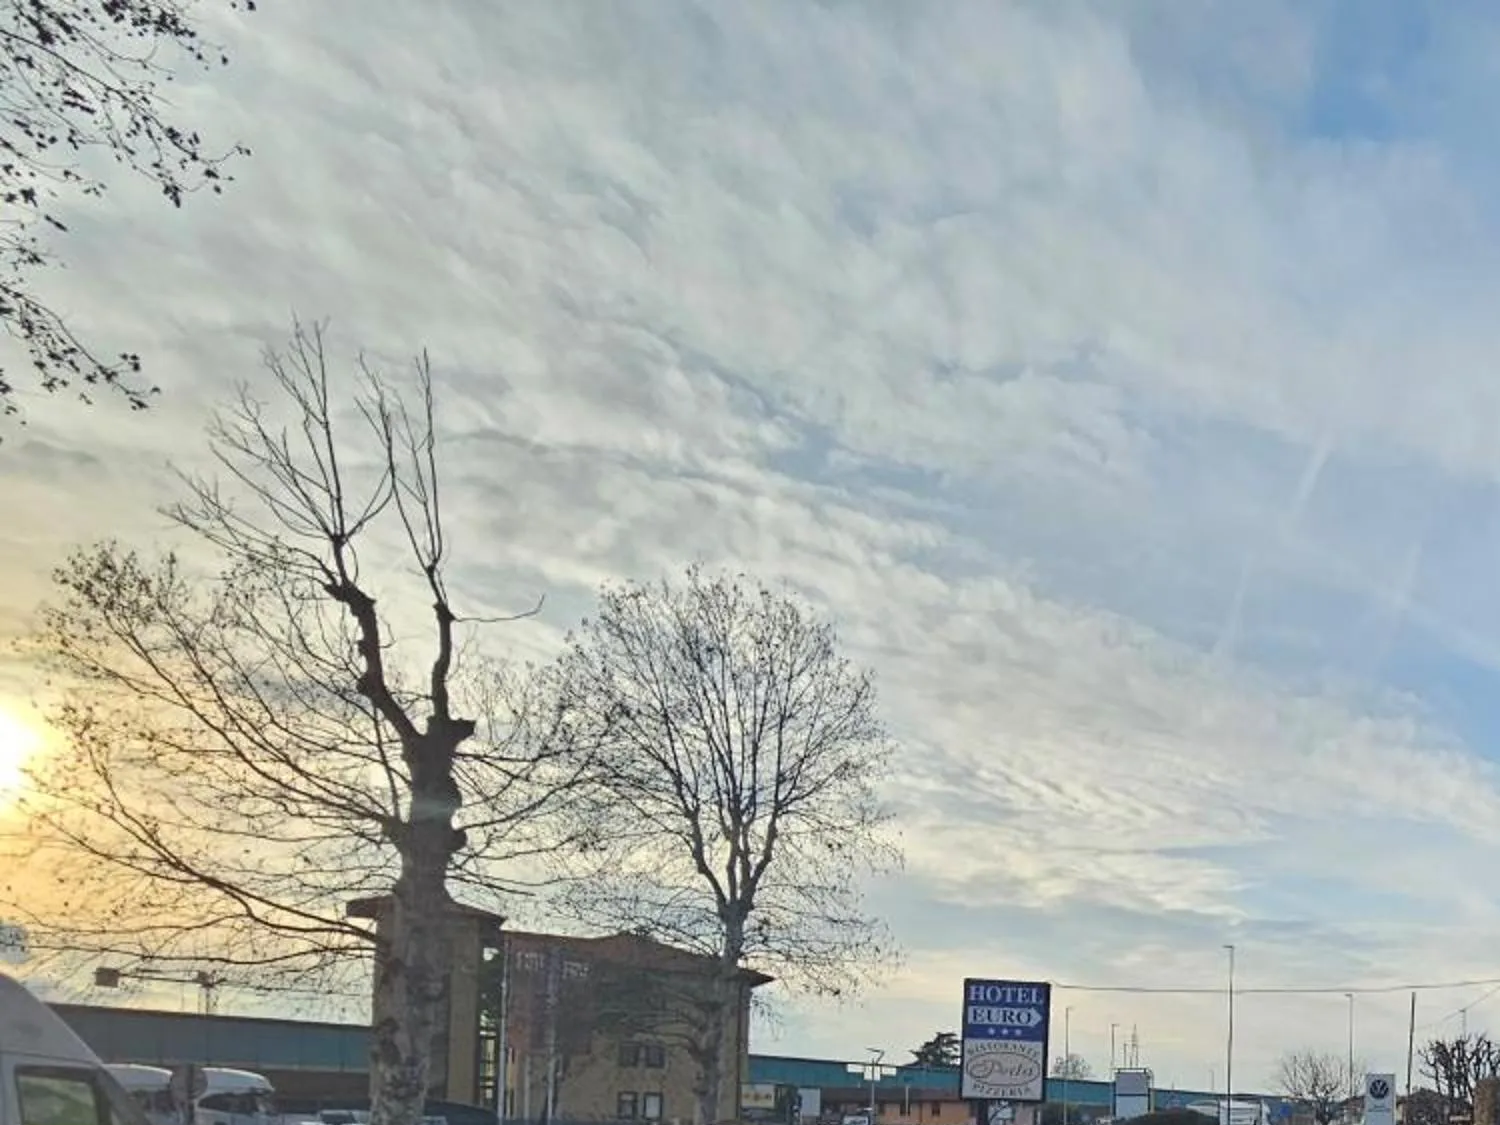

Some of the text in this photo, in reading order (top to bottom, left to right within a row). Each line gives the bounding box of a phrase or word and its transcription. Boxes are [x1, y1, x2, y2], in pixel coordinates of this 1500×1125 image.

[969, 985, 1043, 1004] HOTEL
[973, 1007, 1032, 1025] EURO
[972, 1083, 1031, 1098] PIZZERIA
